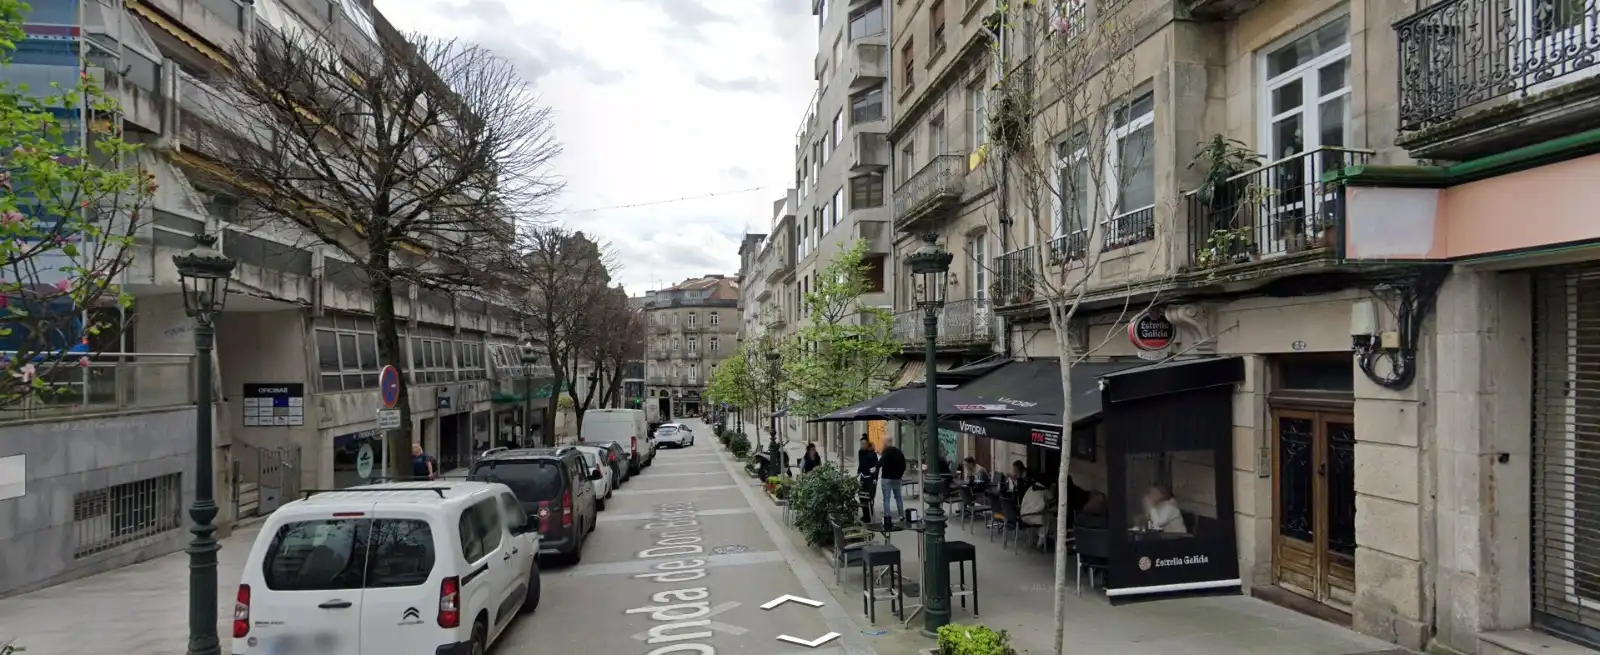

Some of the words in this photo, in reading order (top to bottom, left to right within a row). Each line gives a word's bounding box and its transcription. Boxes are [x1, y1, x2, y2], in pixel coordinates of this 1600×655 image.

[1141, 321, 1169, 330] Estrella
[1141, 329, 1168, 338] Galicia
[1155, 557, 1183, 567] Estrella
[1183, 554, 1209, 564] Galicia
